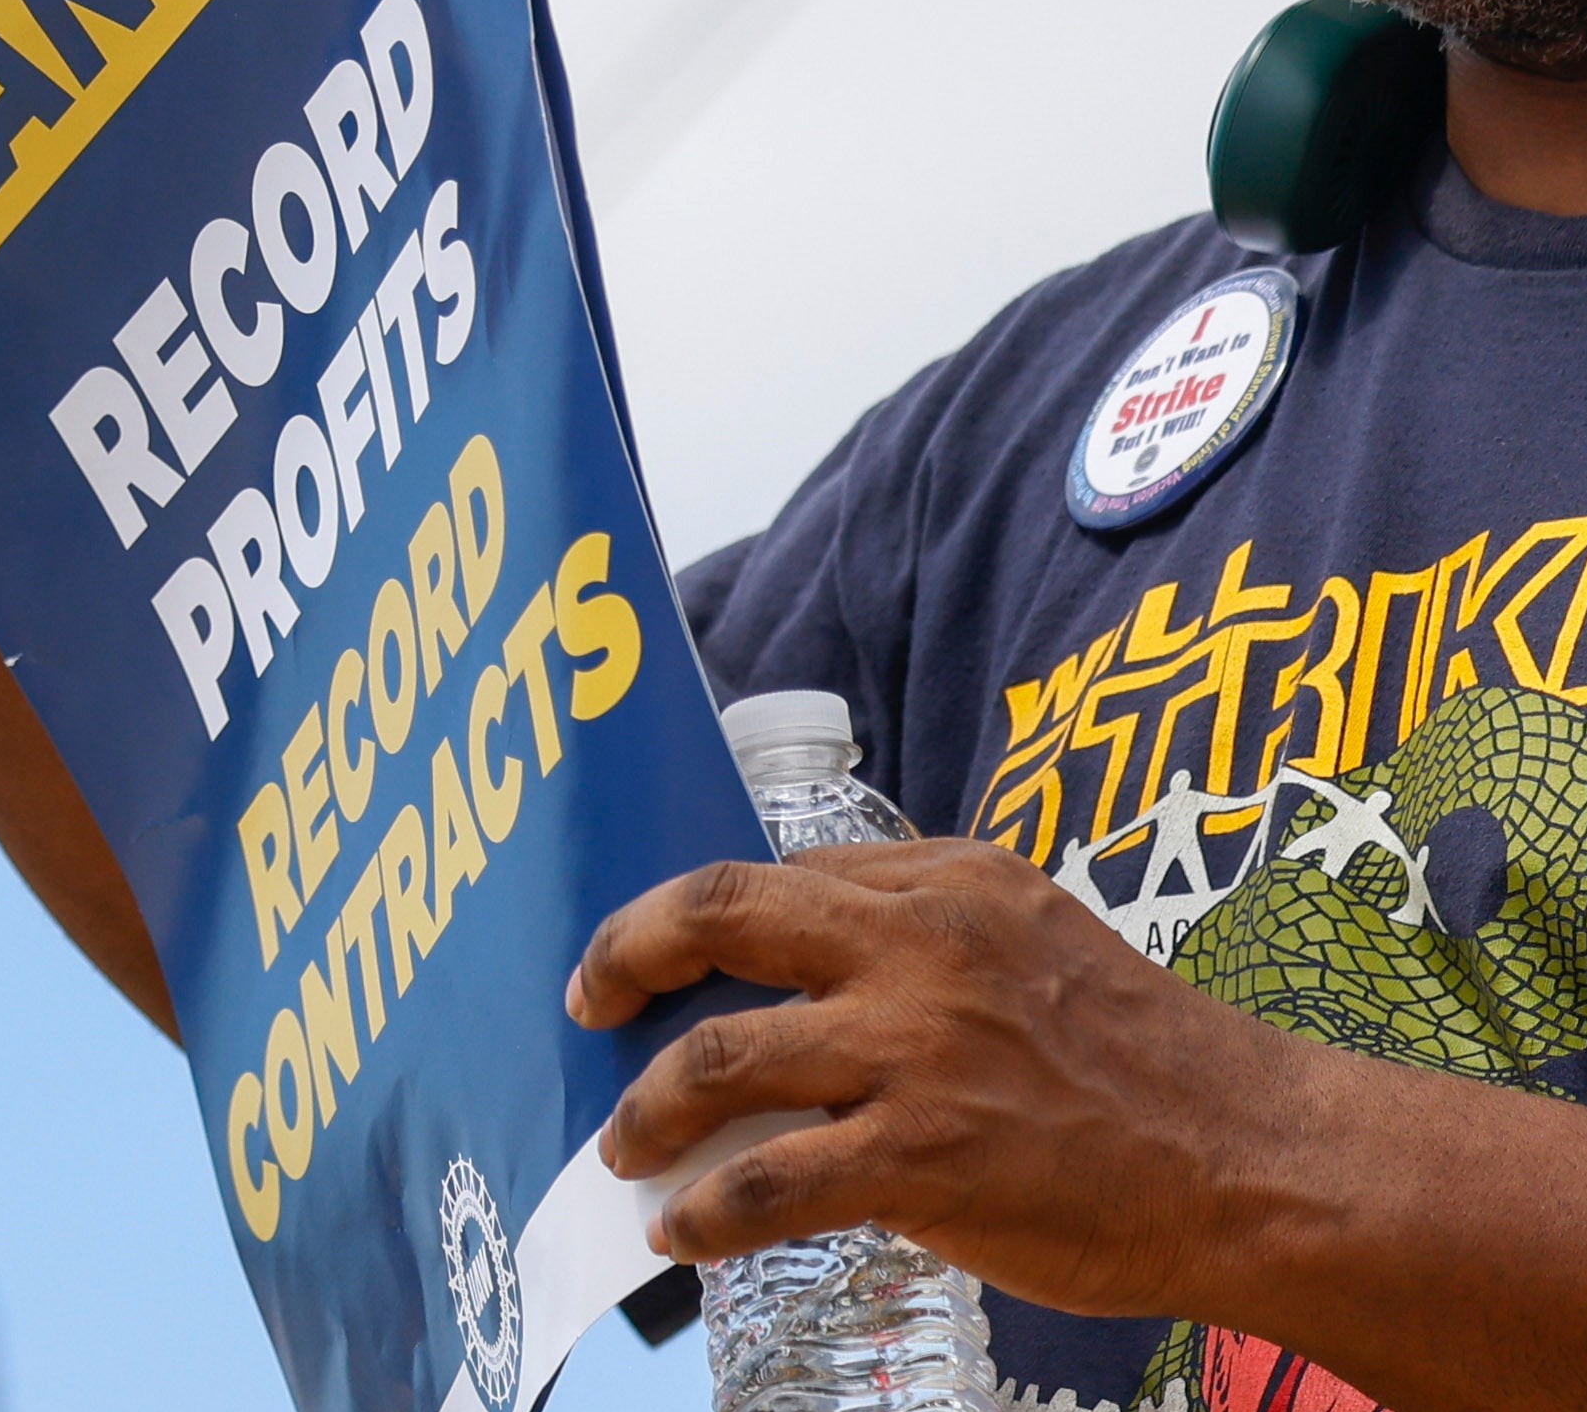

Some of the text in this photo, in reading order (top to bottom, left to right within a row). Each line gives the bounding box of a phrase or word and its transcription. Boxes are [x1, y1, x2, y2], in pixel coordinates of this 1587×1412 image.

[1189, 306, 1216, 344] I
[1125, 332, 1253, 390] Don't Want to
[1109, 433, 1144, 458] But
[1160, 407, 1209, 442] Will!
[1110, 372, 1228, 435] Strike
[148, 179, 476, 741] PROFITS
[235, 434, 506, 970] RECORD
[225, 531, 641, 1243] CONTRACTS
